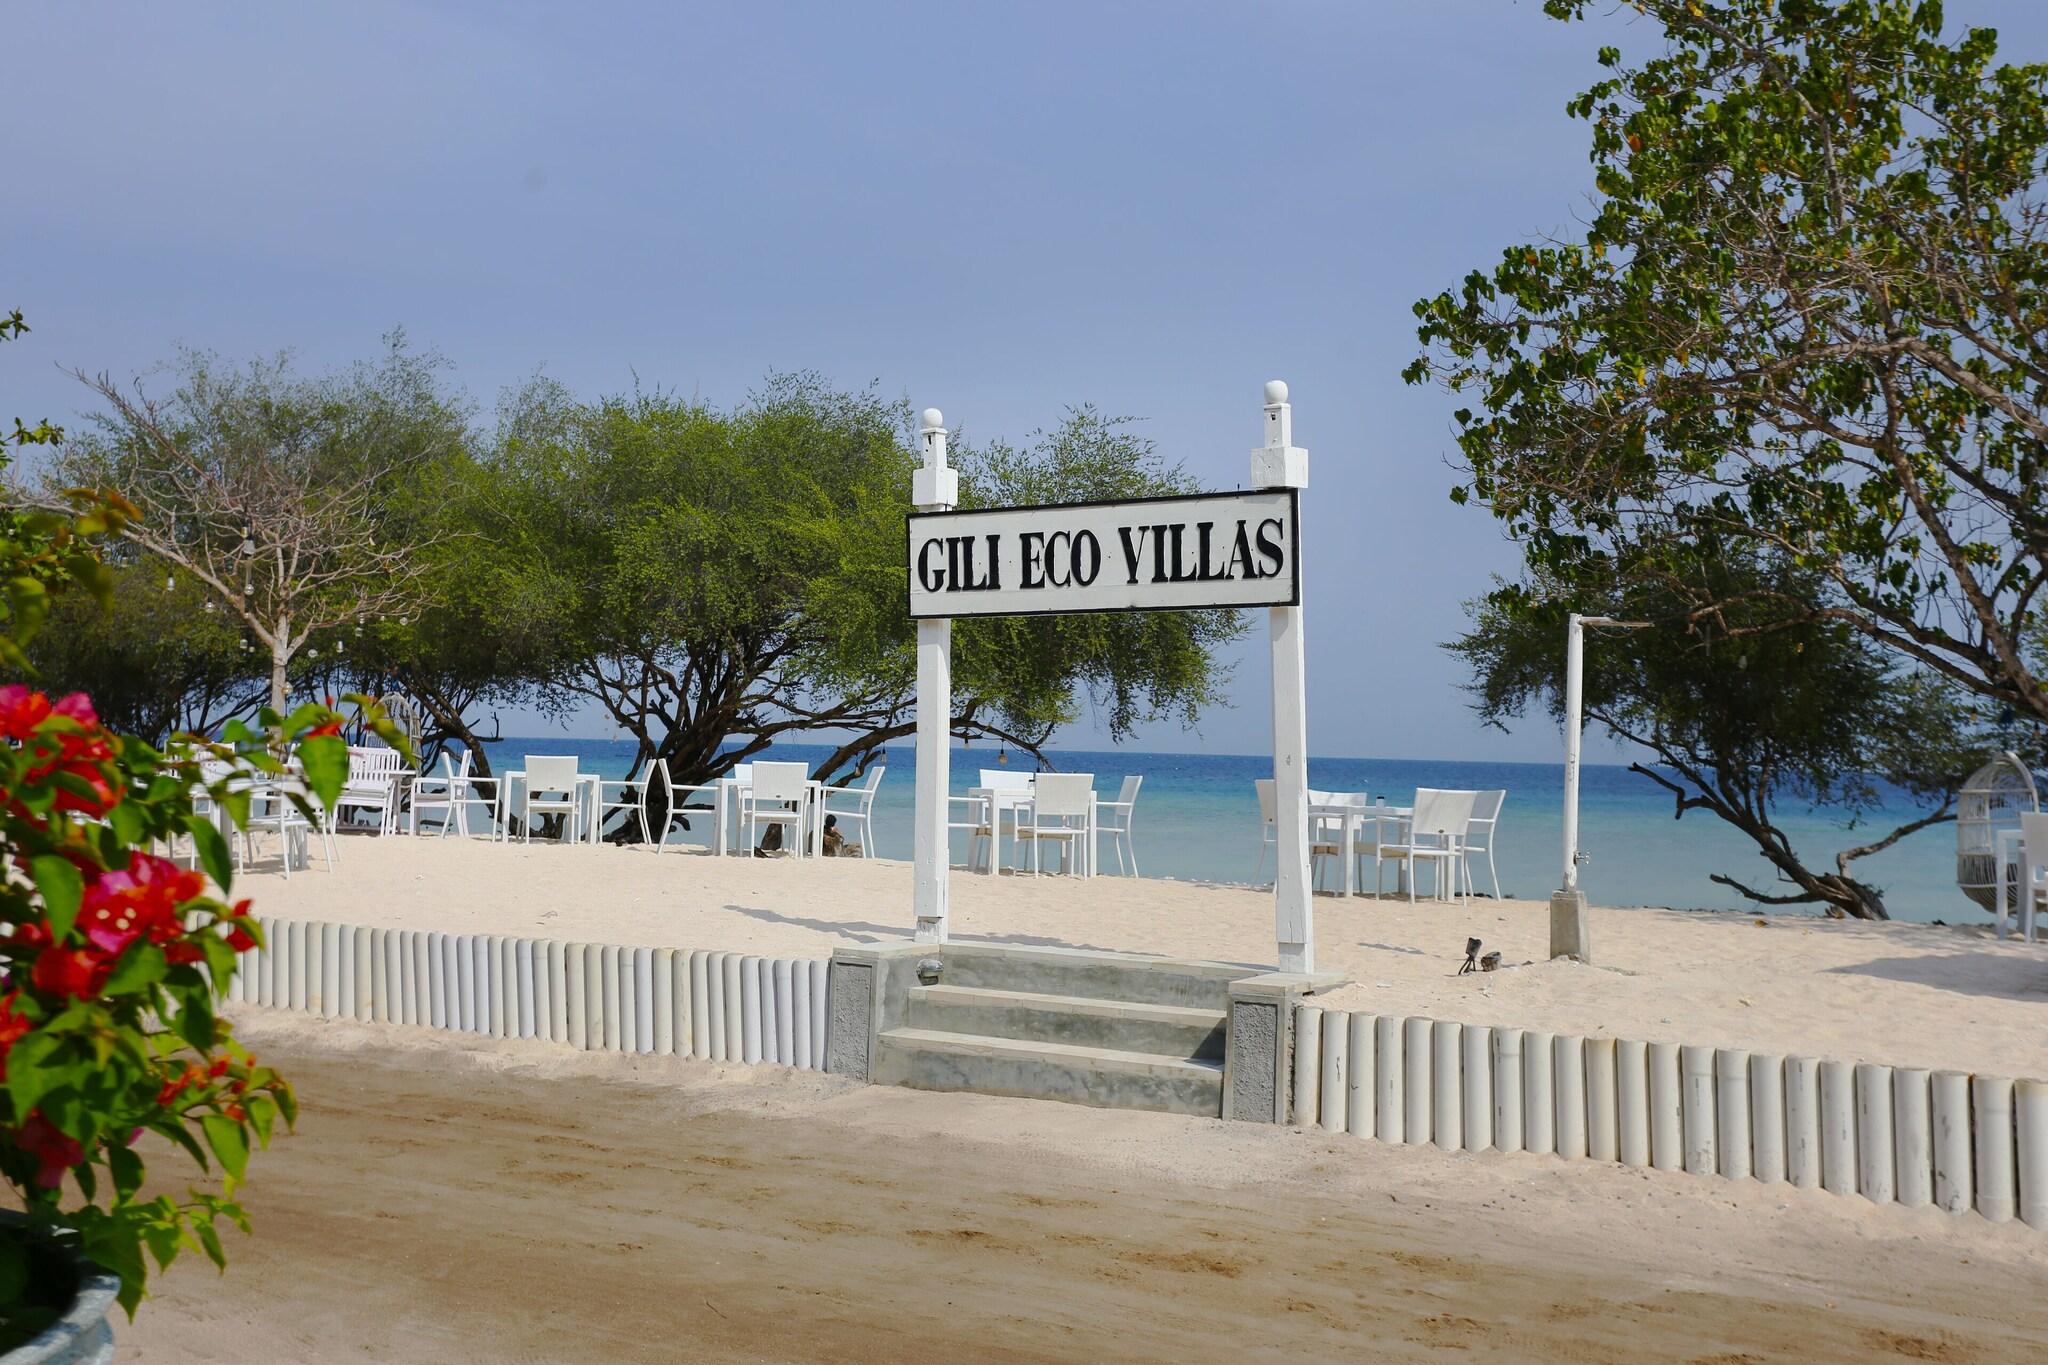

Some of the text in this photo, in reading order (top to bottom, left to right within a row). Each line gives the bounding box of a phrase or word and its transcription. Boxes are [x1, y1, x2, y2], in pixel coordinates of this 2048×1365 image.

[918, 518, 1284, 592] GILI ECO VILLAS
